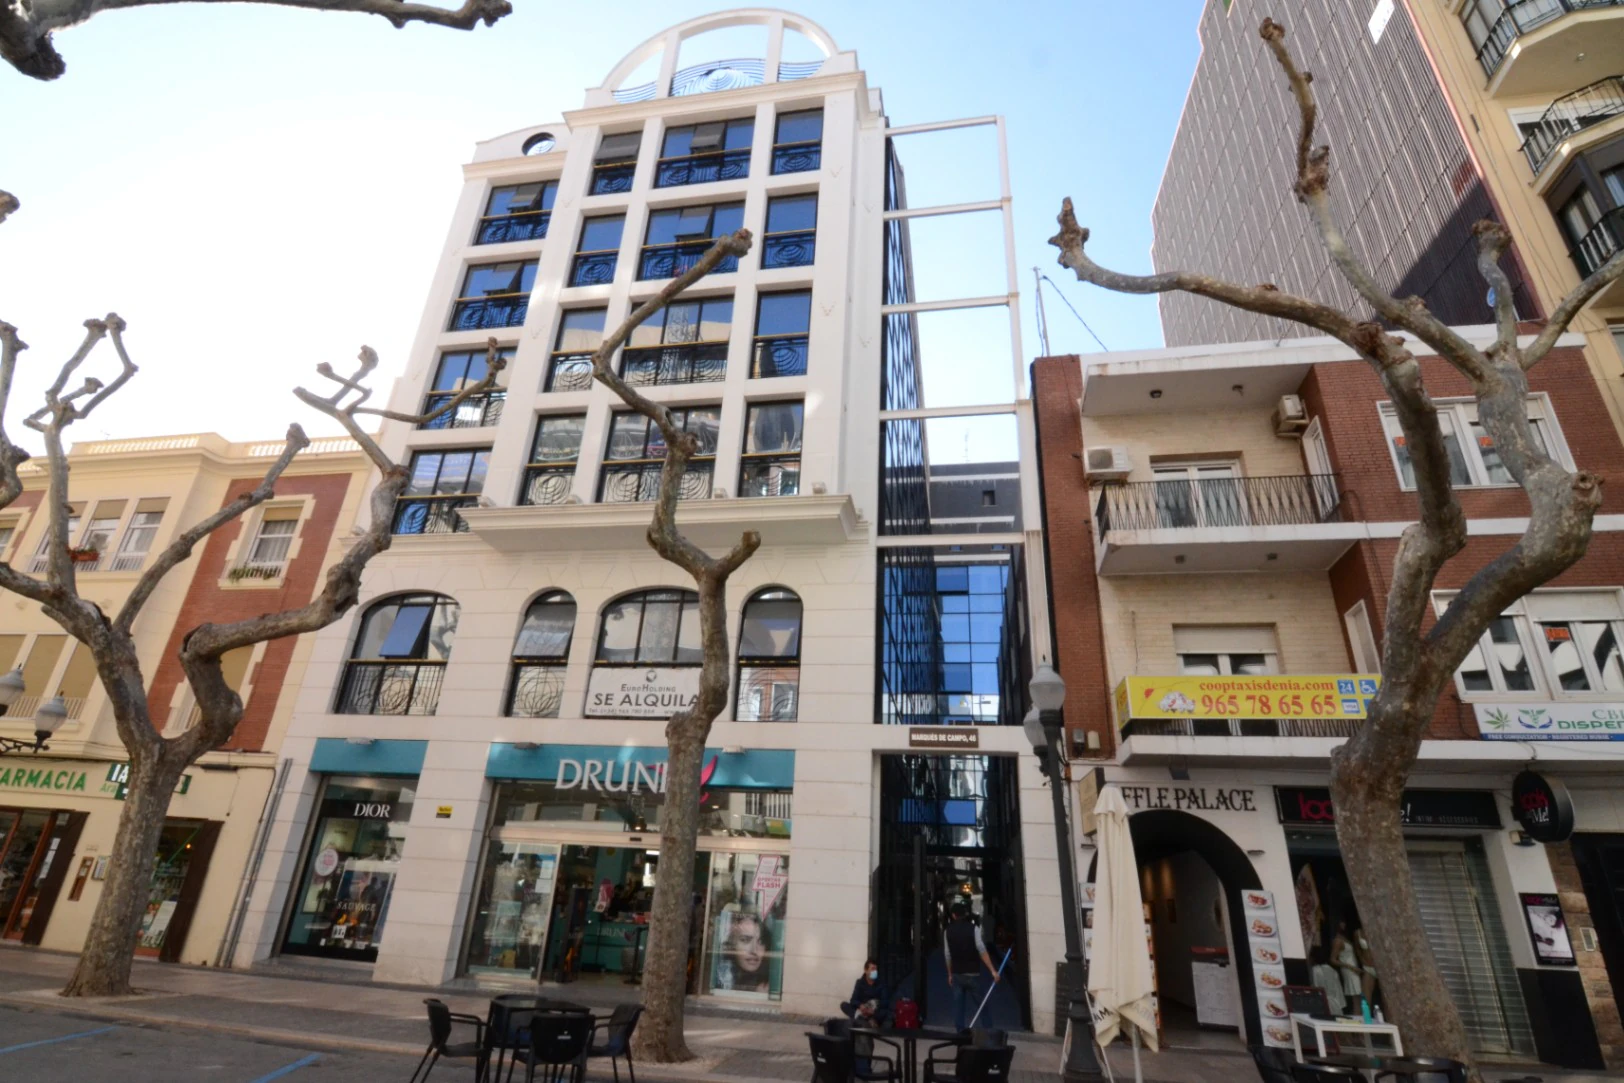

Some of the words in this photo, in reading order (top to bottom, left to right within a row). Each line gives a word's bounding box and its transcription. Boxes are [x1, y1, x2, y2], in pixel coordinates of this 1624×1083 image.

[1199, 680, 1334, 693] cooptaxisdenia.com
[594, 693, 614, 706] SE
[1201, 694, 1240, 715] 965
[1246, 695, 1272, 715] 78
[1279, 695, 1304, 715] 65
[1311, 695, 1336, 715] 65
[1174, 788, 1256, 811] PALACE
[1298, 792, 1335, 820] loo
[353, 803, 391, 818] DIOR
[337, 901, 376, 912] SAUVAGE
